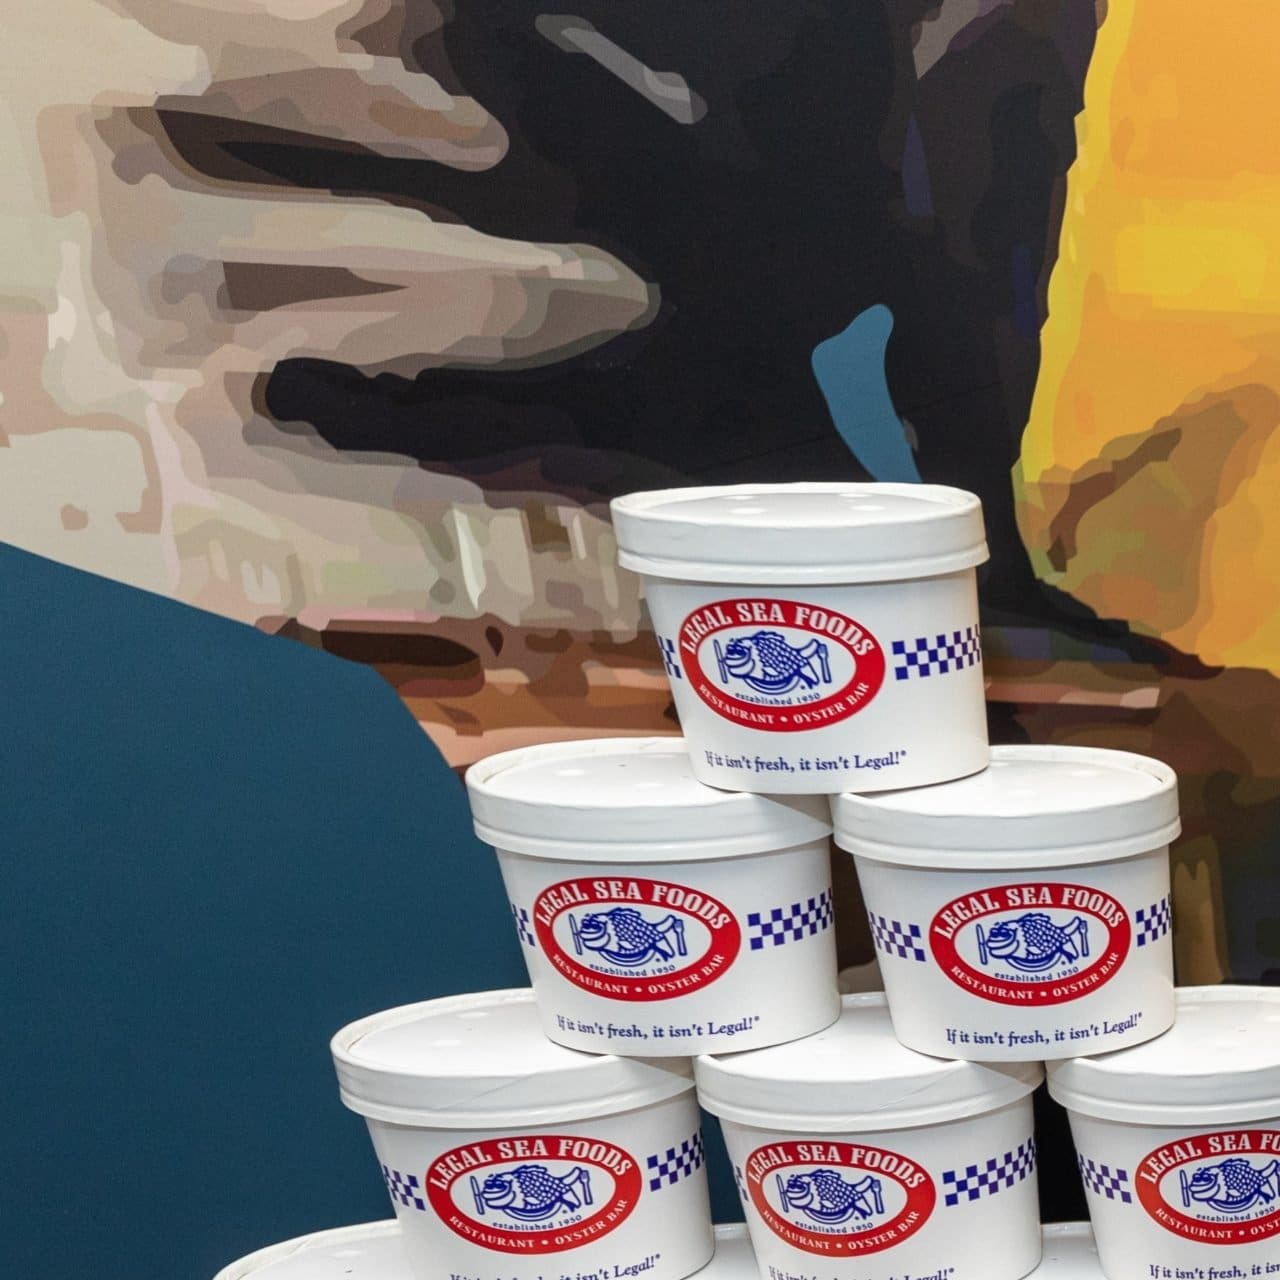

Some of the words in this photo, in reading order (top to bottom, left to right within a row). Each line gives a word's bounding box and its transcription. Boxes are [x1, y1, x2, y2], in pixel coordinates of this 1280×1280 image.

[681, 606, 732, 654] LEGAL
[739, 602, 785, 623] SEA
[796, 607, 875, 656] FOODS
[700, 685, 774, 724] RESTAURANT
[794, 702, 845, 724] OYSTER
[846, 682, 869, 705] BAR
[705, 751, 713, 767] If
[714, 754, 724, 766] it
[726, 754, 752, 769] isn't
[755, 757, 794, 772] fresh,
[800, 757, 811, 770] it
[816, 754, 849, 769] isn't
[854, 752, 900, 769] Legal!
[535, 883, 587, 927] LEGAL
[596, 881, 642, 899] SEA
[652, 885, 731, 929] FOODS
[933, 893, 999, 940] LEGAL
[1005, 887, 1053, 907] SEA
[1062, 888, 1125, 928] FOODS
[553, 953, 628, 994] RESTAURANT
[649, 973, 701, 994] OYSTER
[701, 953, 725, 974] BAR
[952, 965, 1034, 1000] RESTAURANT
[1053, 973, 1099, 998] OYSTER
[1100, 952, 1119, 974] BAR
[558, 1015, 565, 1030] If
[567, 1017, 575, 1030] it
[577, 1019, 603, 1035] isn't
[608, 1024, 648, 1039] fresh,
[653, 1025, 664, 1037] it
[668, 1023, 702, 1038] isn't
[708, 1017, 752, 1036] Legal!
[946, 1029, 957, 1045] If
[959, 1029, 970, 1043] it
[974, 1031, 1004, 1044] isn't
[1008, 1030, 1049, 1046] fresh,
[1055, 1029, 1065, 1041] it
[1070, 1025, 1099, 1040] isn't
[1103, 1015, 1138, 1036] Legal!
[430, 1146, 493, 1190] LEGAL
[500, 1139, 549, 1159] SEA
[558, 1140, 633, 1176] FOODS
[748, 1146, 793, 1184] LEGAL
[798, 1143, 842, 1162] SEA
[850, 1147, 926, 1189] FOODS
[1140, 1141, 1202, 1184] LEGAL
[1208, 1133, 1252, 1153] SEA
[449, 1215, 535, 1248] RESTAURANT
[555, 1220, 607, 1245] OYSTER
[607, 1199, 628, 1222] BAR
[848, 1230, 896, 1250] OYSTER
[898, 1210, 920, 1232] BAR
[1155, 1208, 1233, 1239] RESTAURANT
[614, 1256, 654, 1278] Legal!
[1150, 1264, 1160, 1278] If
[1162, 1265, 1172, 1278] it
[1175, 1266, 1204, 1279] isn't
[1208, 1267, 1247, 1280] fresh,
[1252, 1264, 1261, 1276] it
